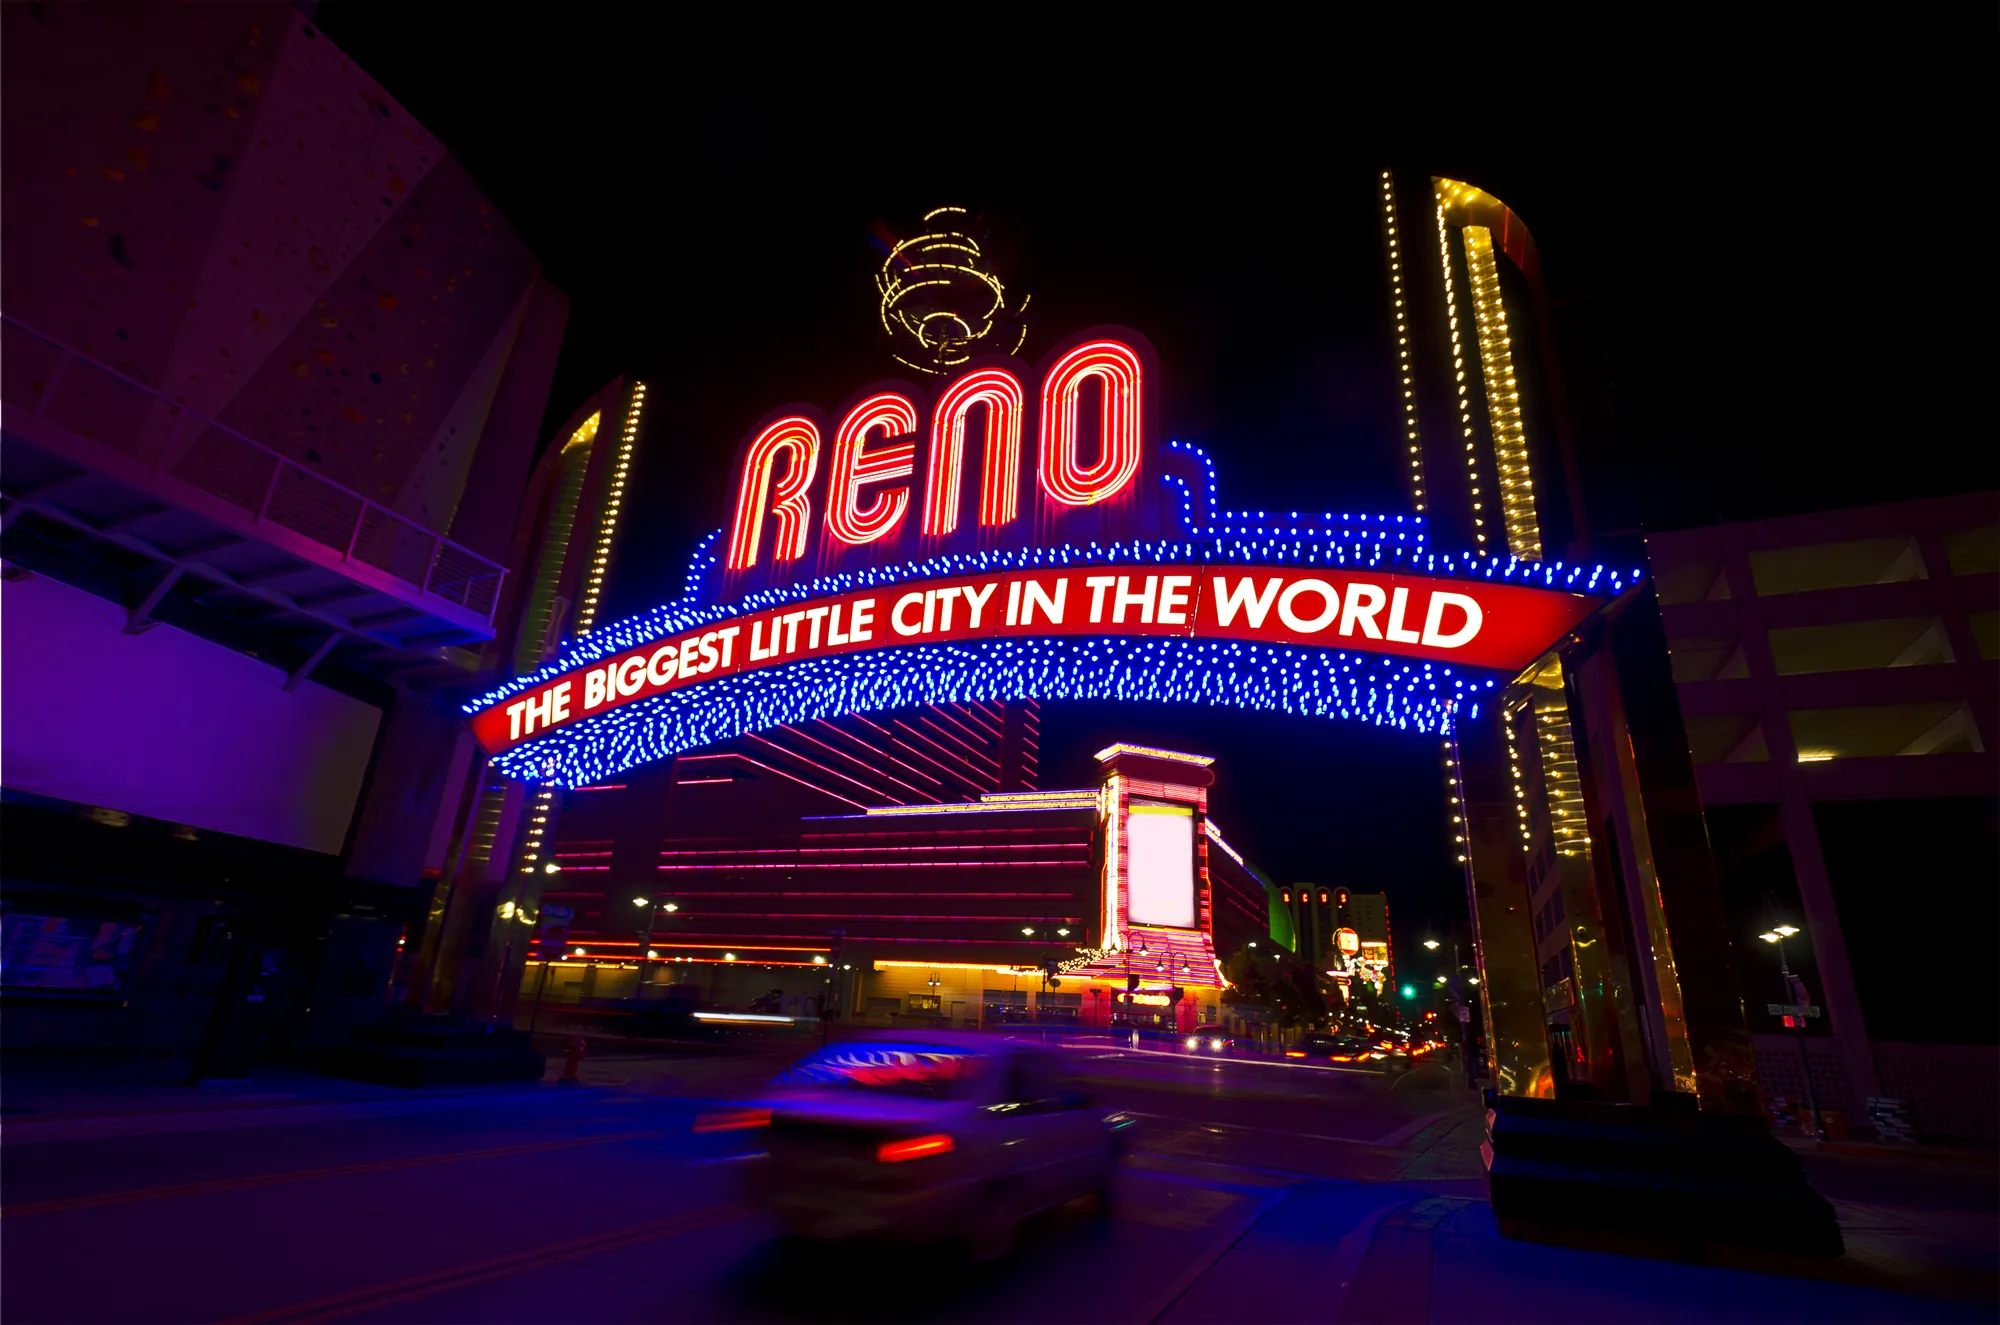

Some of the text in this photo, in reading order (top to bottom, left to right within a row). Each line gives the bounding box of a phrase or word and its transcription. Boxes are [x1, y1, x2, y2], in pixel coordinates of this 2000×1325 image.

[727, 338, 1143, 571] RENO
[505, 575, 1484, 741] THE BIGGEST LITTLE CITY IN THE WORLD
